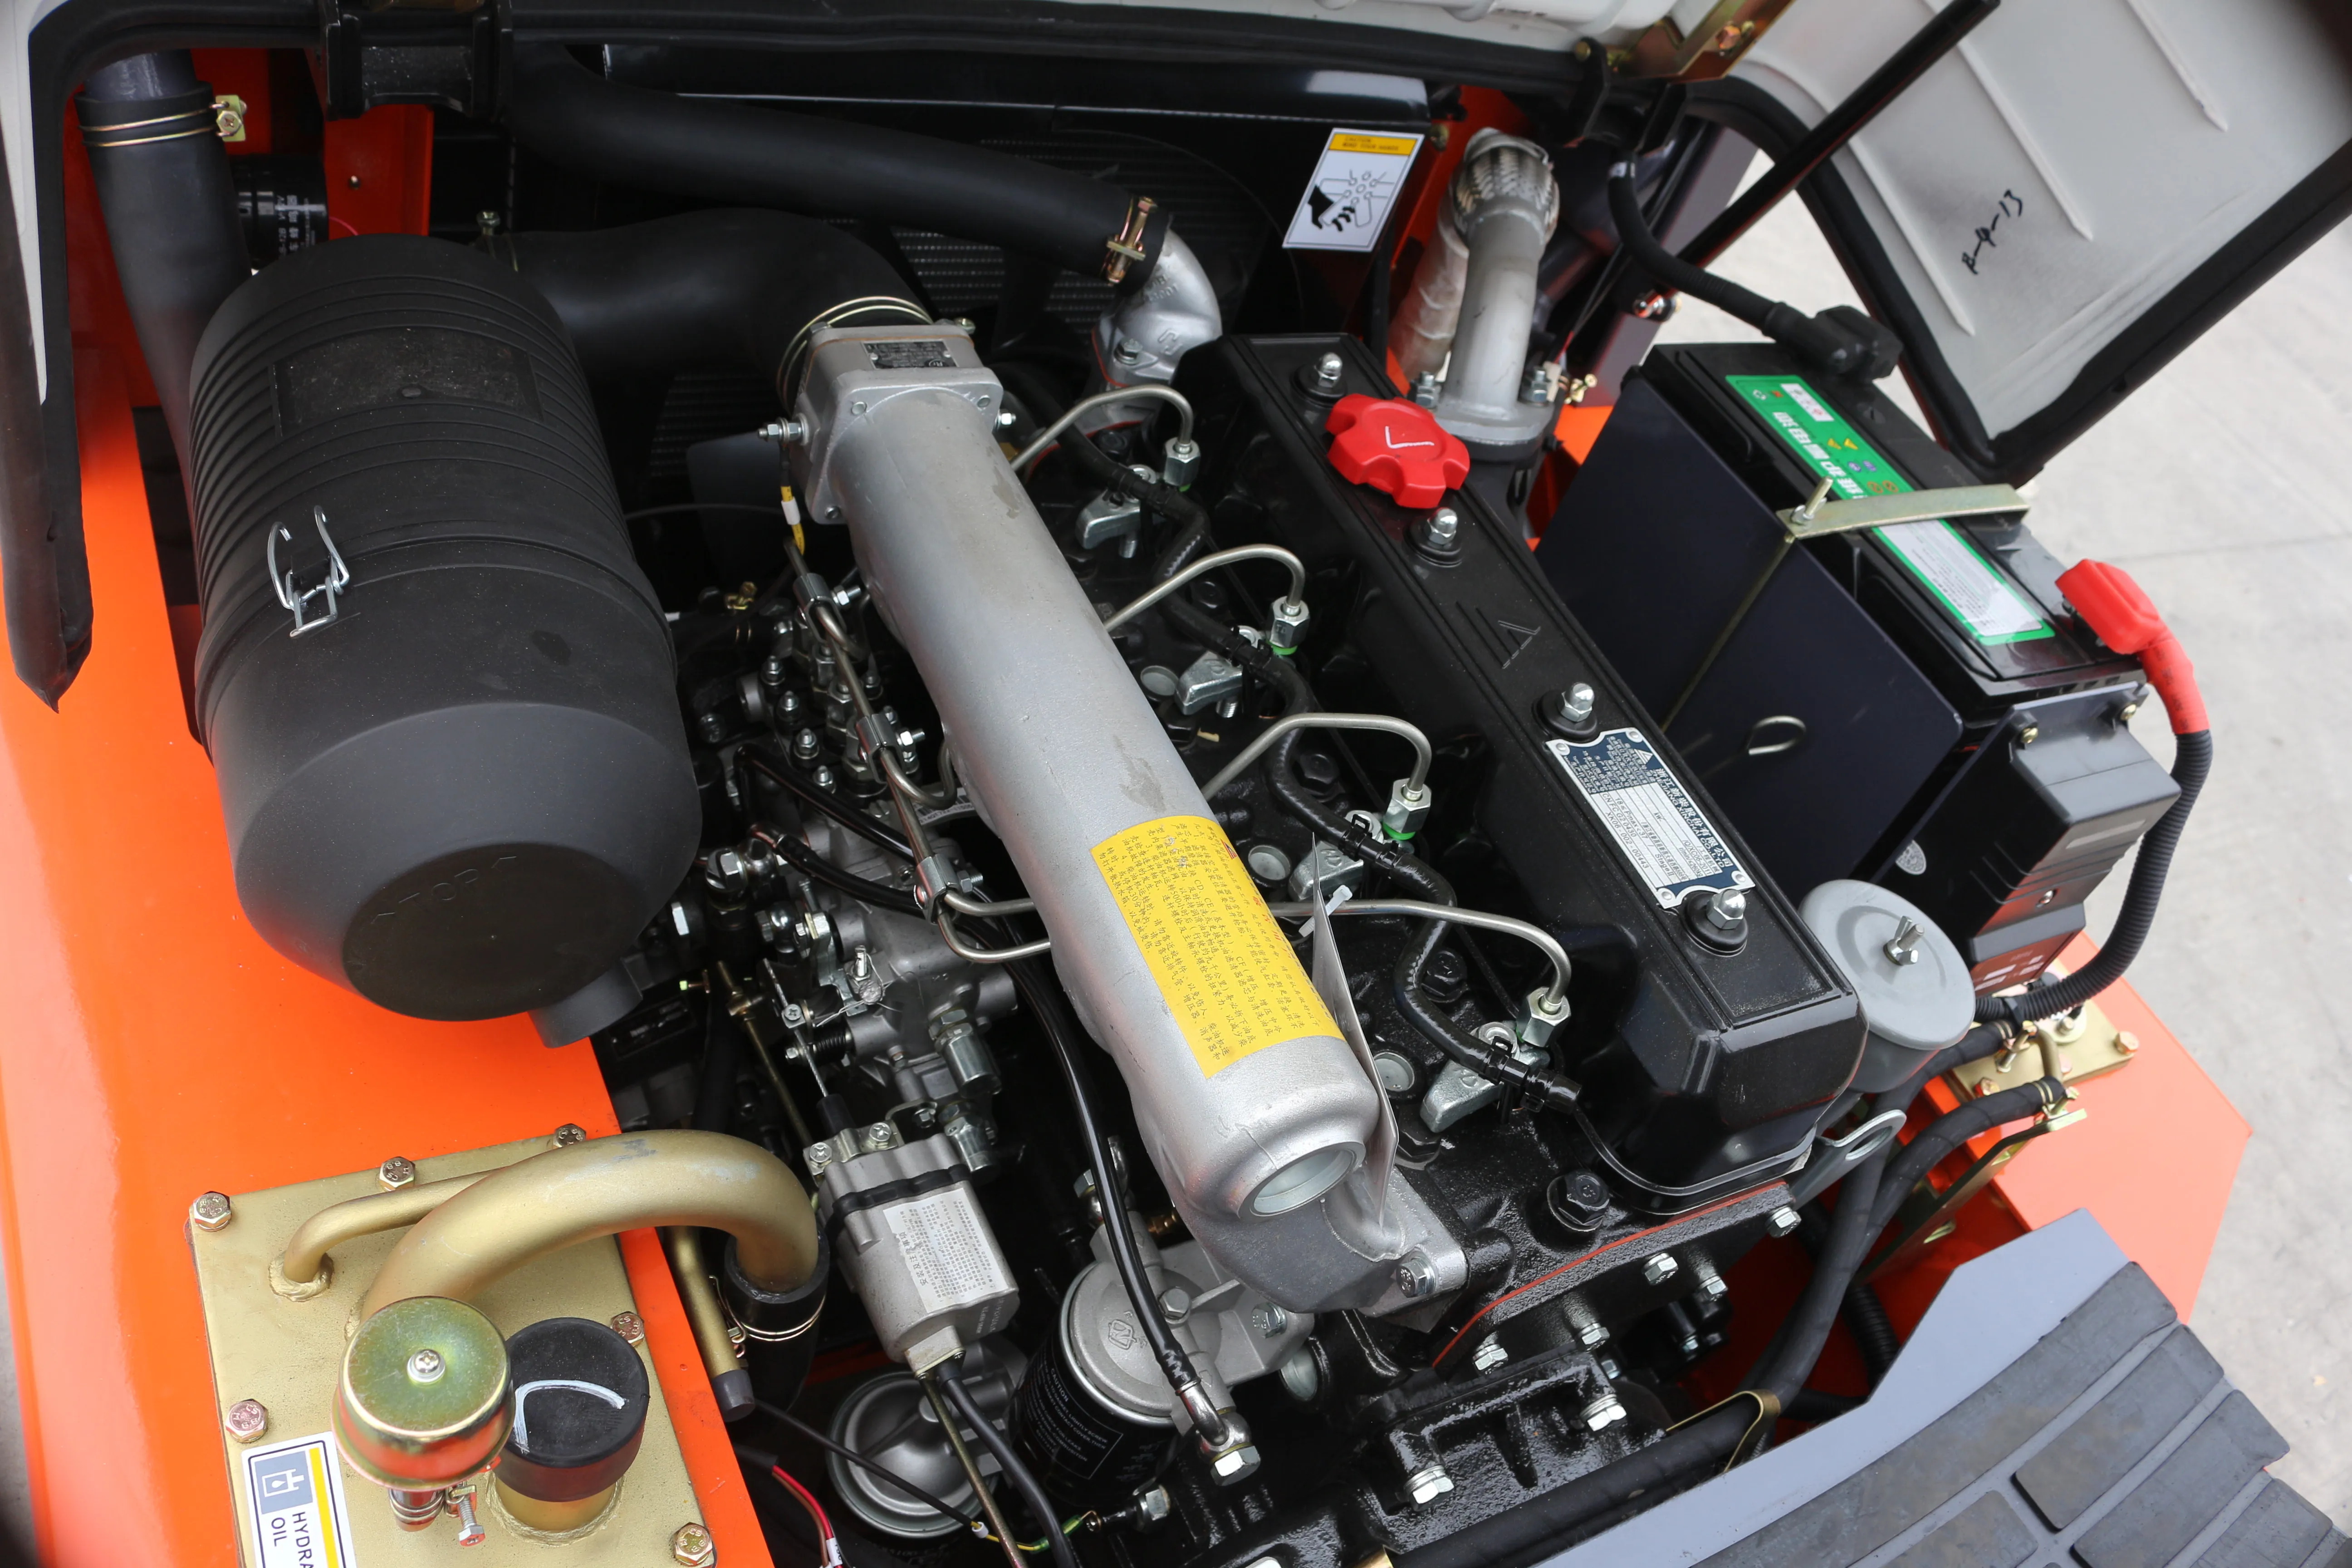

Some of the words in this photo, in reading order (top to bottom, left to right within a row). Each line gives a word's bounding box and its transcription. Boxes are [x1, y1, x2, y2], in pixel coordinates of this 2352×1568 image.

[1649, 769, 1680, 805] ZHEJIANG
[1676, 806, 1702, 836] XINCHAI
[1654, 768, 1735, 867] 浙江新柴股份有限公司
[1051, 1368, 1068, 1402] CAUTION
[1054, 1406, 1073, 1428] CONTACT
[1069, 1414, 1088, 1431] LIGHTLY
[1064, 1437, 1081, 1451] LEAKS
[271, 1517, 288, 1547] OIL
